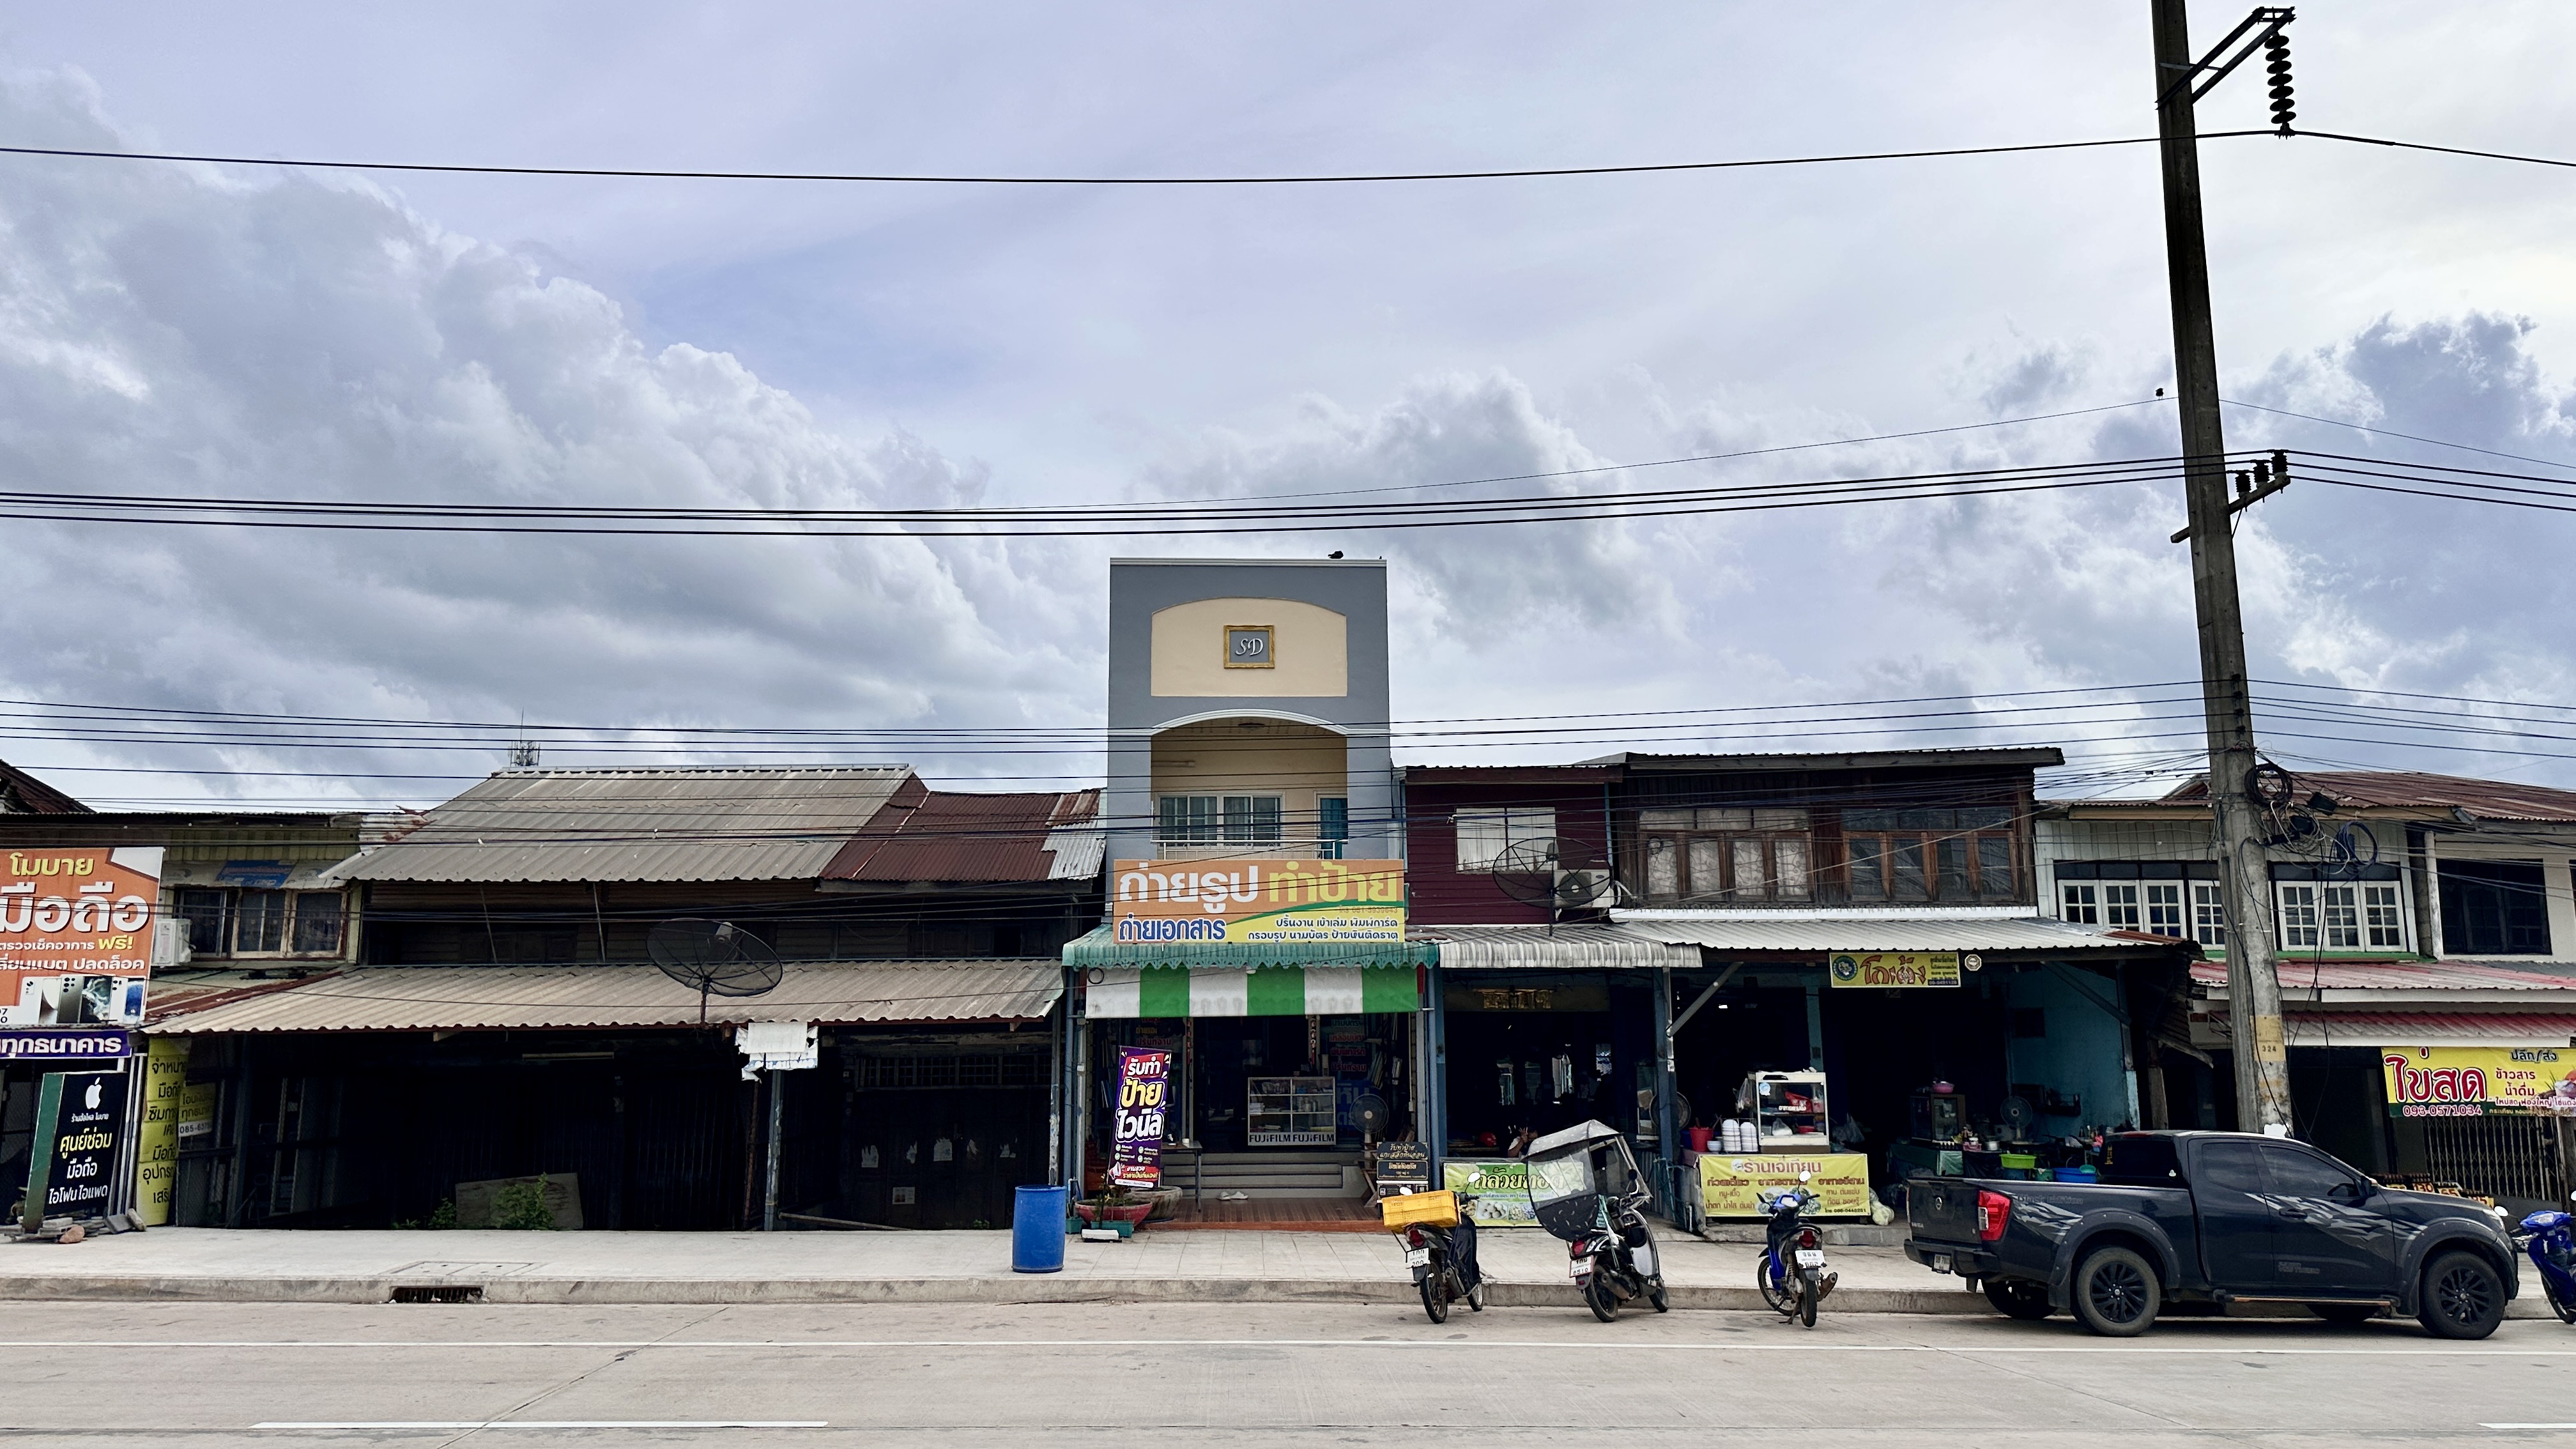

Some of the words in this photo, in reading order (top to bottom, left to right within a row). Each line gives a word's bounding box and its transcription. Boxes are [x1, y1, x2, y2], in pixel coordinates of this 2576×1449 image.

[1235, 638, 1264, 656] SD
[10, 852, 94, 876] โมบาย
[1119, 862, 1259, 914] ถ่ายรูป
[1269, 861, 1397, 902] ทำป้าย
[1119, 914, 1226, 940] ถ่ายเอกสาร
[1276, 914, 1314, 926] ปริ้นงาน
[98, 935, 134, 951] ฟรี!
[1248, 931, 1287, 943] กรอบรูป
[1290, 929, 1329, 940] นามบัตร
[73, 954, 145, 970] ปลดล็อค
[0, 1037, 122, 1057] ทุกธนาคาร
[2510, 1049, 2557, 1062] ปลีก/ส่ง
[1127, 1055, 1161, 1075] รับทำ
[2384, 1048, 2486, 1101] ไข่สด
[2496, 1067, 2536, 1080] ข้าวสาร
[1121, 1078, 1163, 1108] ป้าย
[2505, 1082, 2535, 1096] น้ำดื่ม
[2404, 1105, 2483, 1117] 093-0571034
[1116, 1108, 1163, 1139] ไวนิล
[59, 1127, 112, 1159] ศูนย์ซ่อม
[1249, 1134, 1291, 1142] FUJIFILM
[1292, 1133, 1335, 1142] FUJIFILM
[66, 1156, 98, 1179] มือถือ
[1474, 1167, 1566, 1190] กล้วยทอด
[49, 1186, 78, 1204] ไอโฟน
[79, 1184, 108, 1200] ไอแพด
